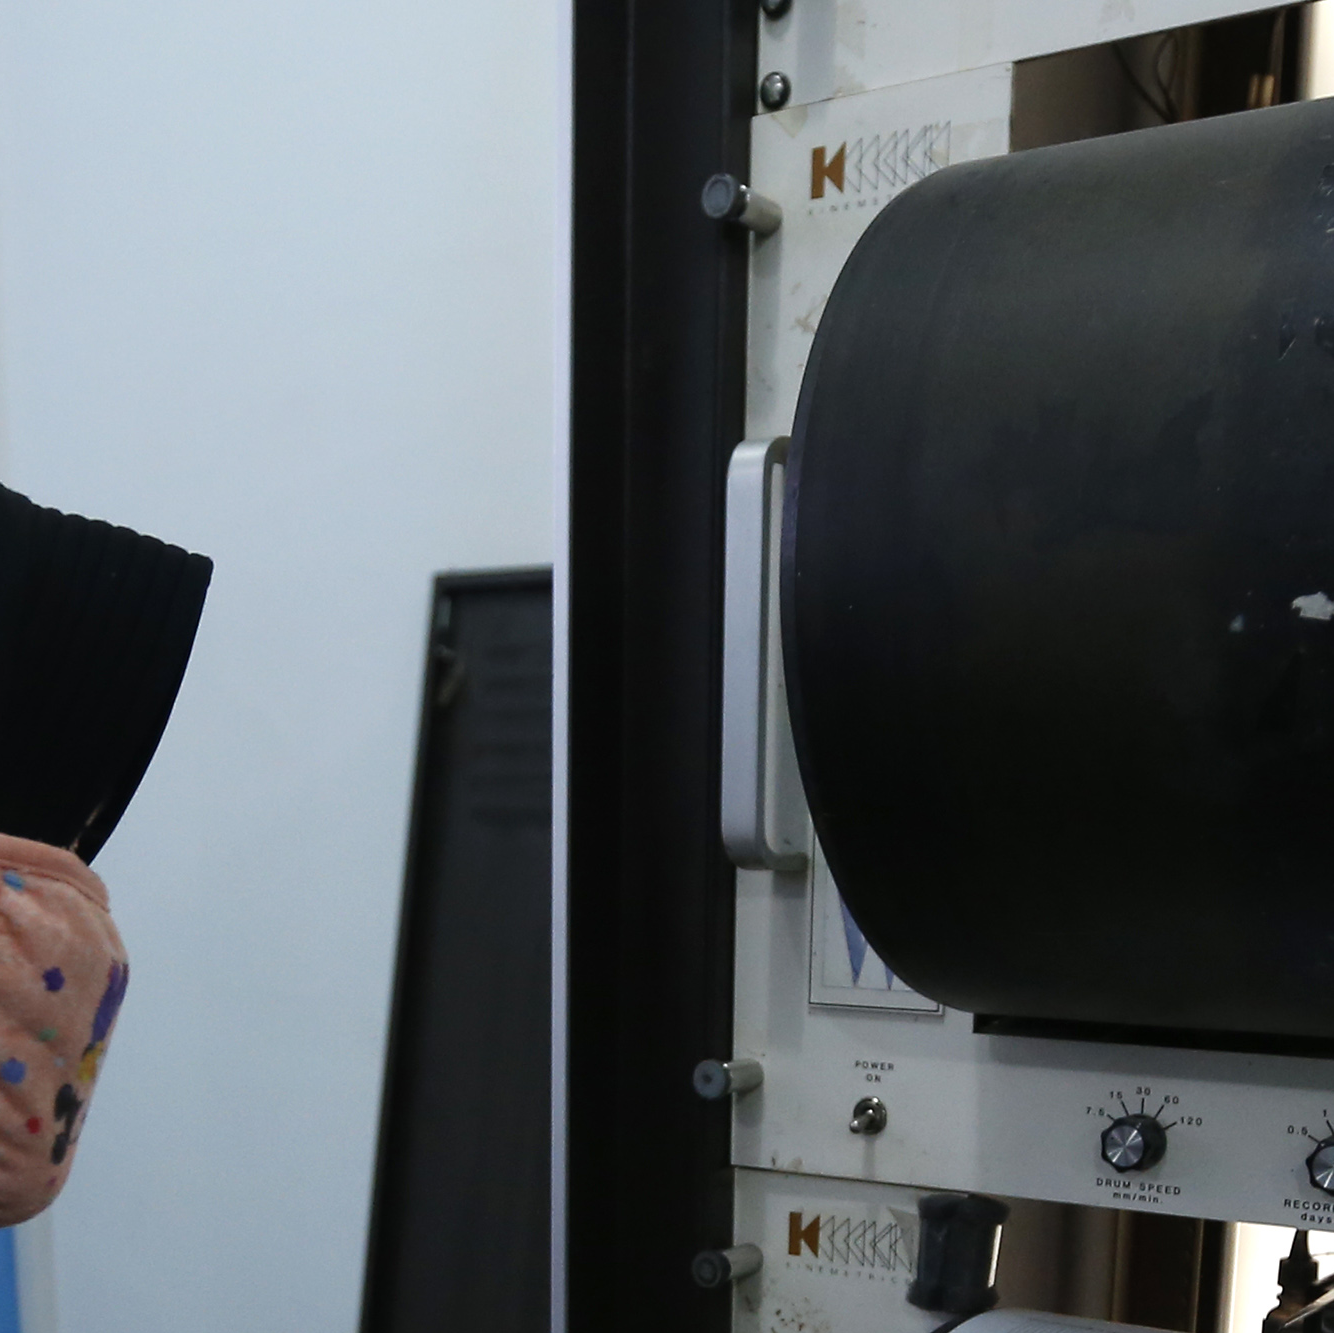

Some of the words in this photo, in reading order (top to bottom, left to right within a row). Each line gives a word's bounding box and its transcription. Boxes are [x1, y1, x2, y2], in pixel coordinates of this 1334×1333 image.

[854, 1059, 895, 1071] POWER
[865, 1073, 881, 1083] ON
[1110, 1090, 1123, 1099] 15
[1136, 1086, 1151, 1096] 30
[1163, 1095, 1180, 1105] 60
[1086, 1106, 1105, 1117] 7.5
[1180, 1116, 1203, 1126] 120
[1287, 1124, 1308, 1136] 0.5
[1096, 1177, 1131, 1189] DRUM
[1139, 1182, 1181, 1196] SPEED
